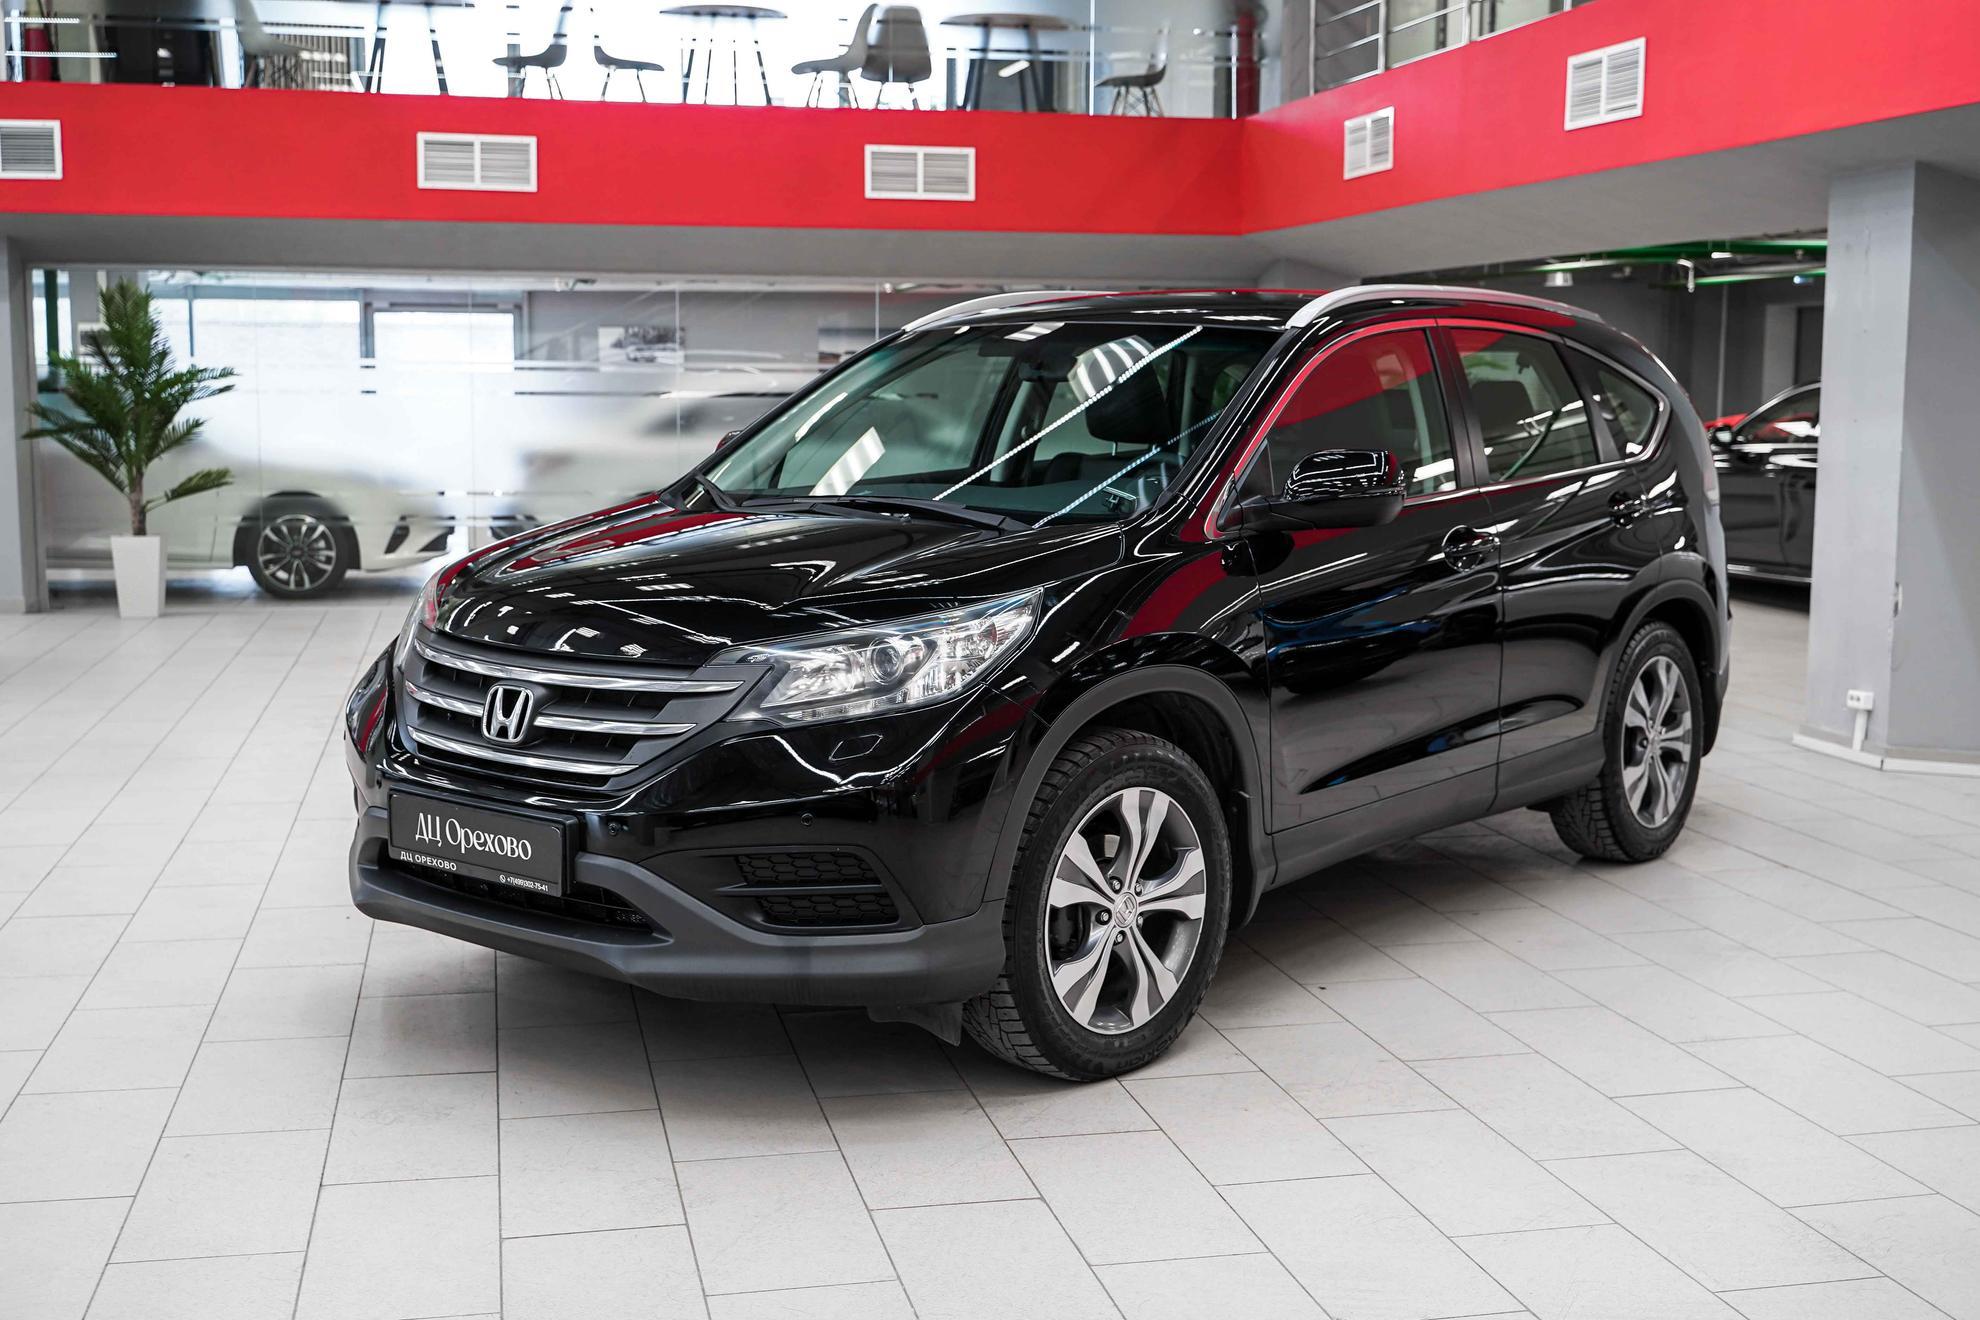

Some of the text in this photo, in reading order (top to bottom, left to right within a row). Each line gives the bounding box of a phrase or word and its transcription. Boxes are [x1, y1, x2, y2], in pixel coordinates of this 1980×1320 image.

[415, 812, 532, 860] ДЦ Орехово
[400, 851, 457, 871] ДЦ ОРЕХОВО
